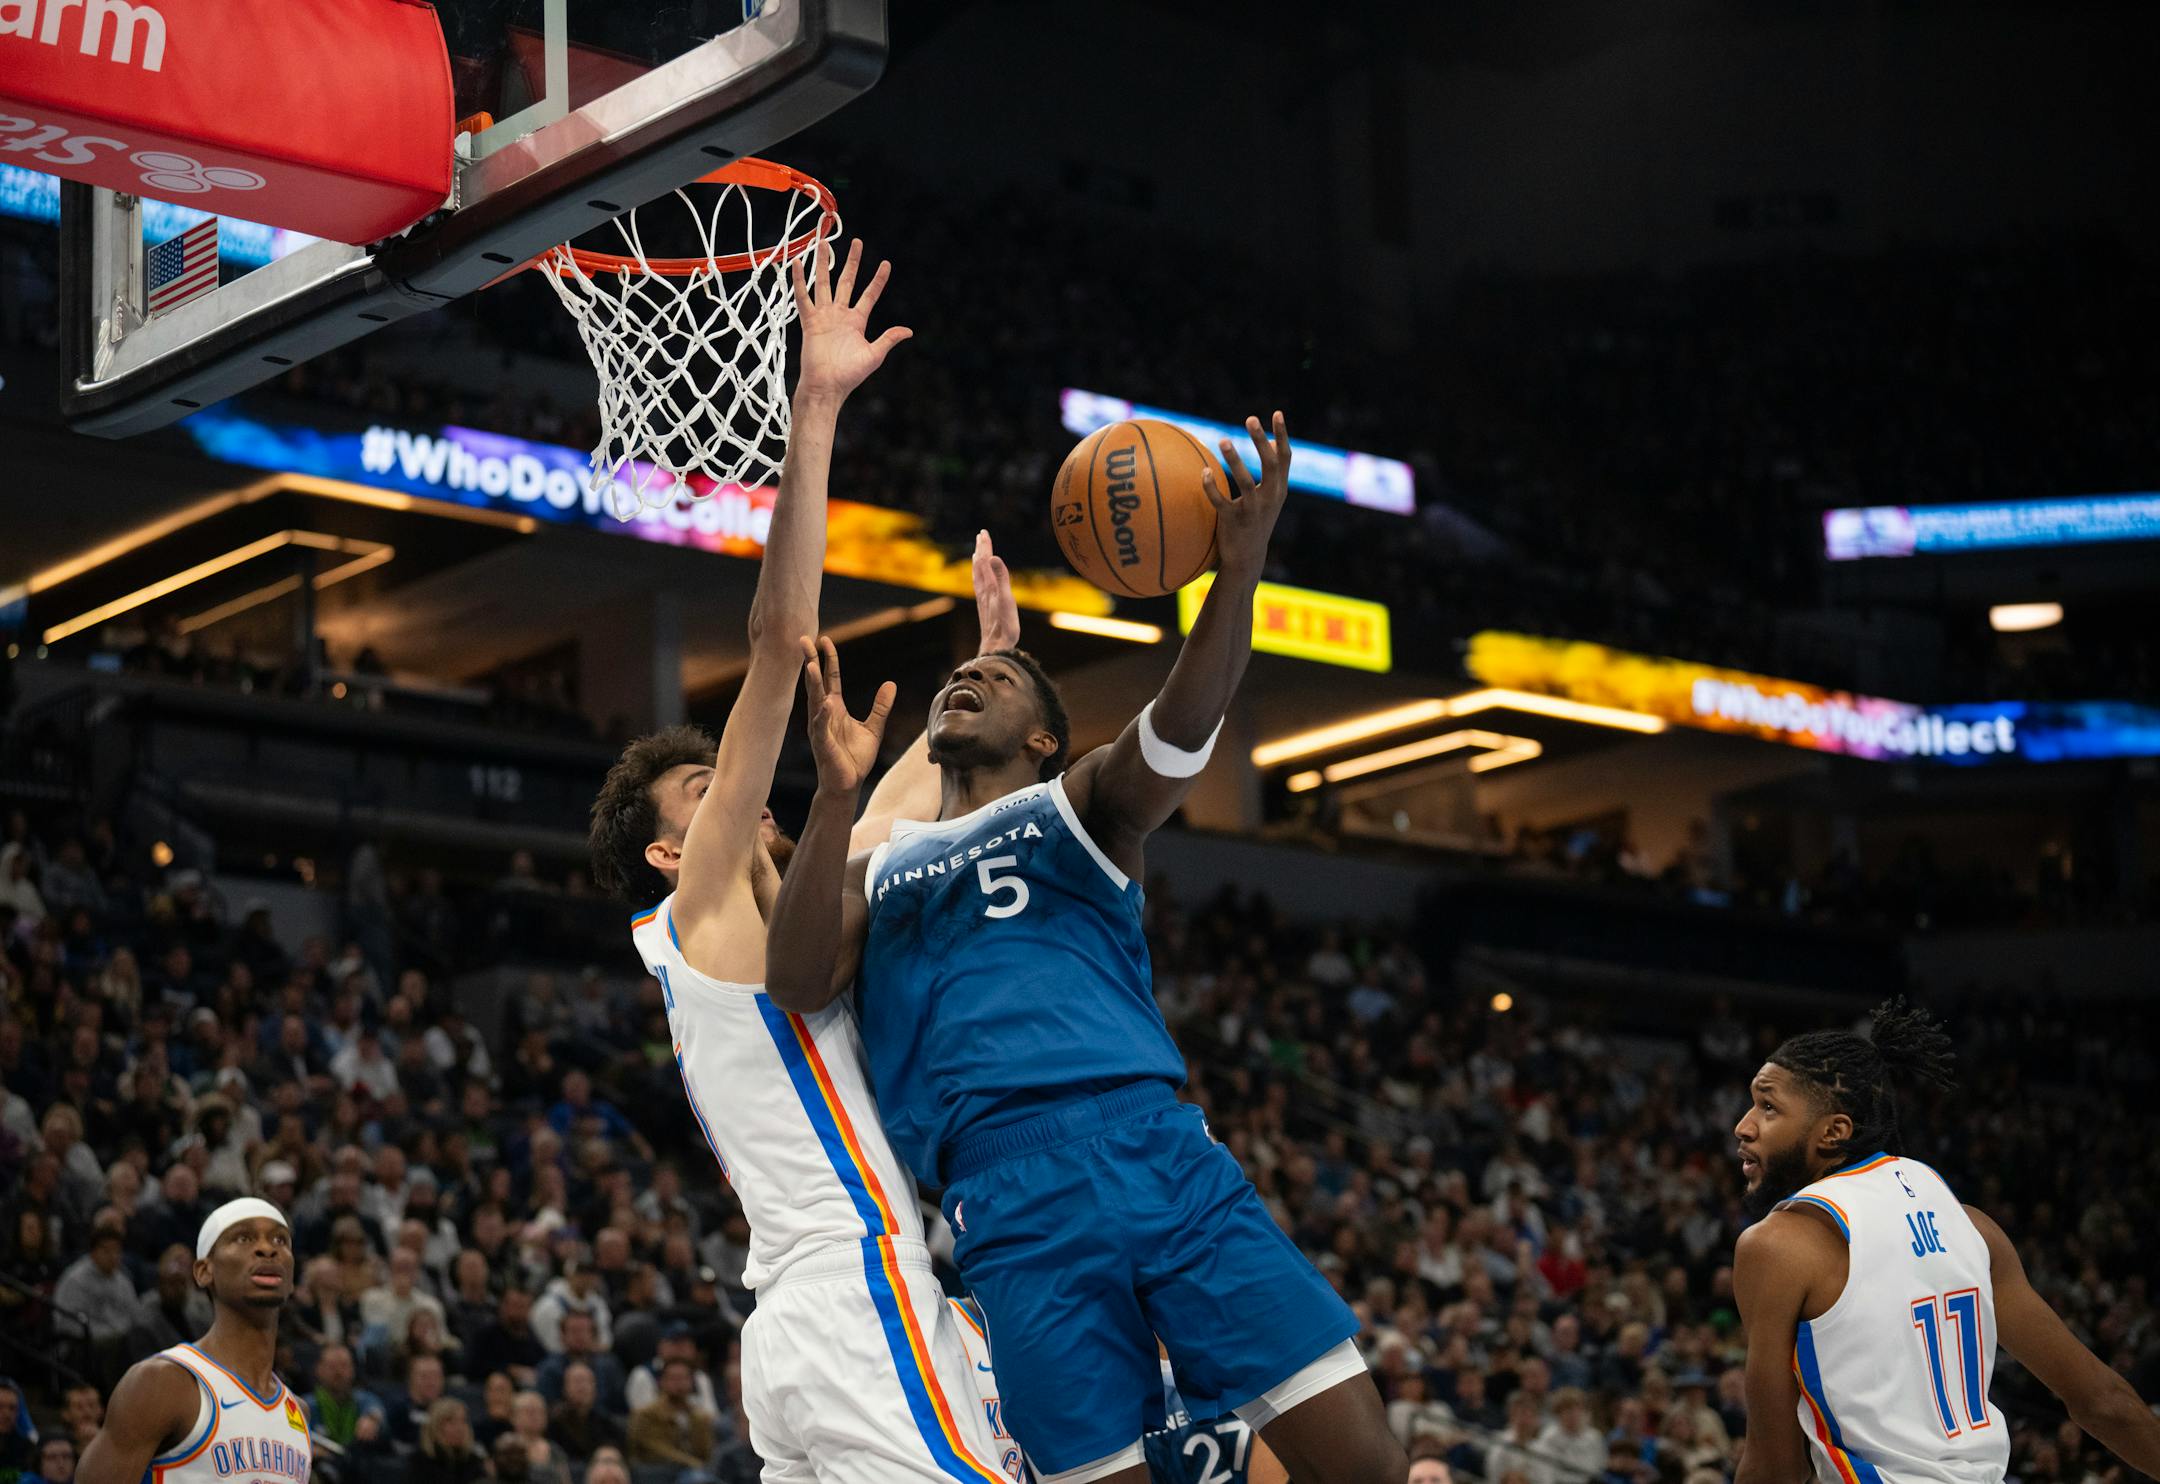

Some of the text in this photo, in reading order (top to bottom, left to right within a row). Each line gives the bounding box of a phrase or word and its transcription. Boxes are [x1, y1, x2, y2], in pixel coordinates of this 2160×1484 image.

[1105, 445, 1141, 568] Wilson
[876, 822, 1043, 902] MINNESOTA
[976, 854, 1030, 919] 5
[1906, 1211, 1947, 1258] JOE
[1911, 1287, 1991, 1439] 11
[1182, 1419, 1251, 1484] 27
